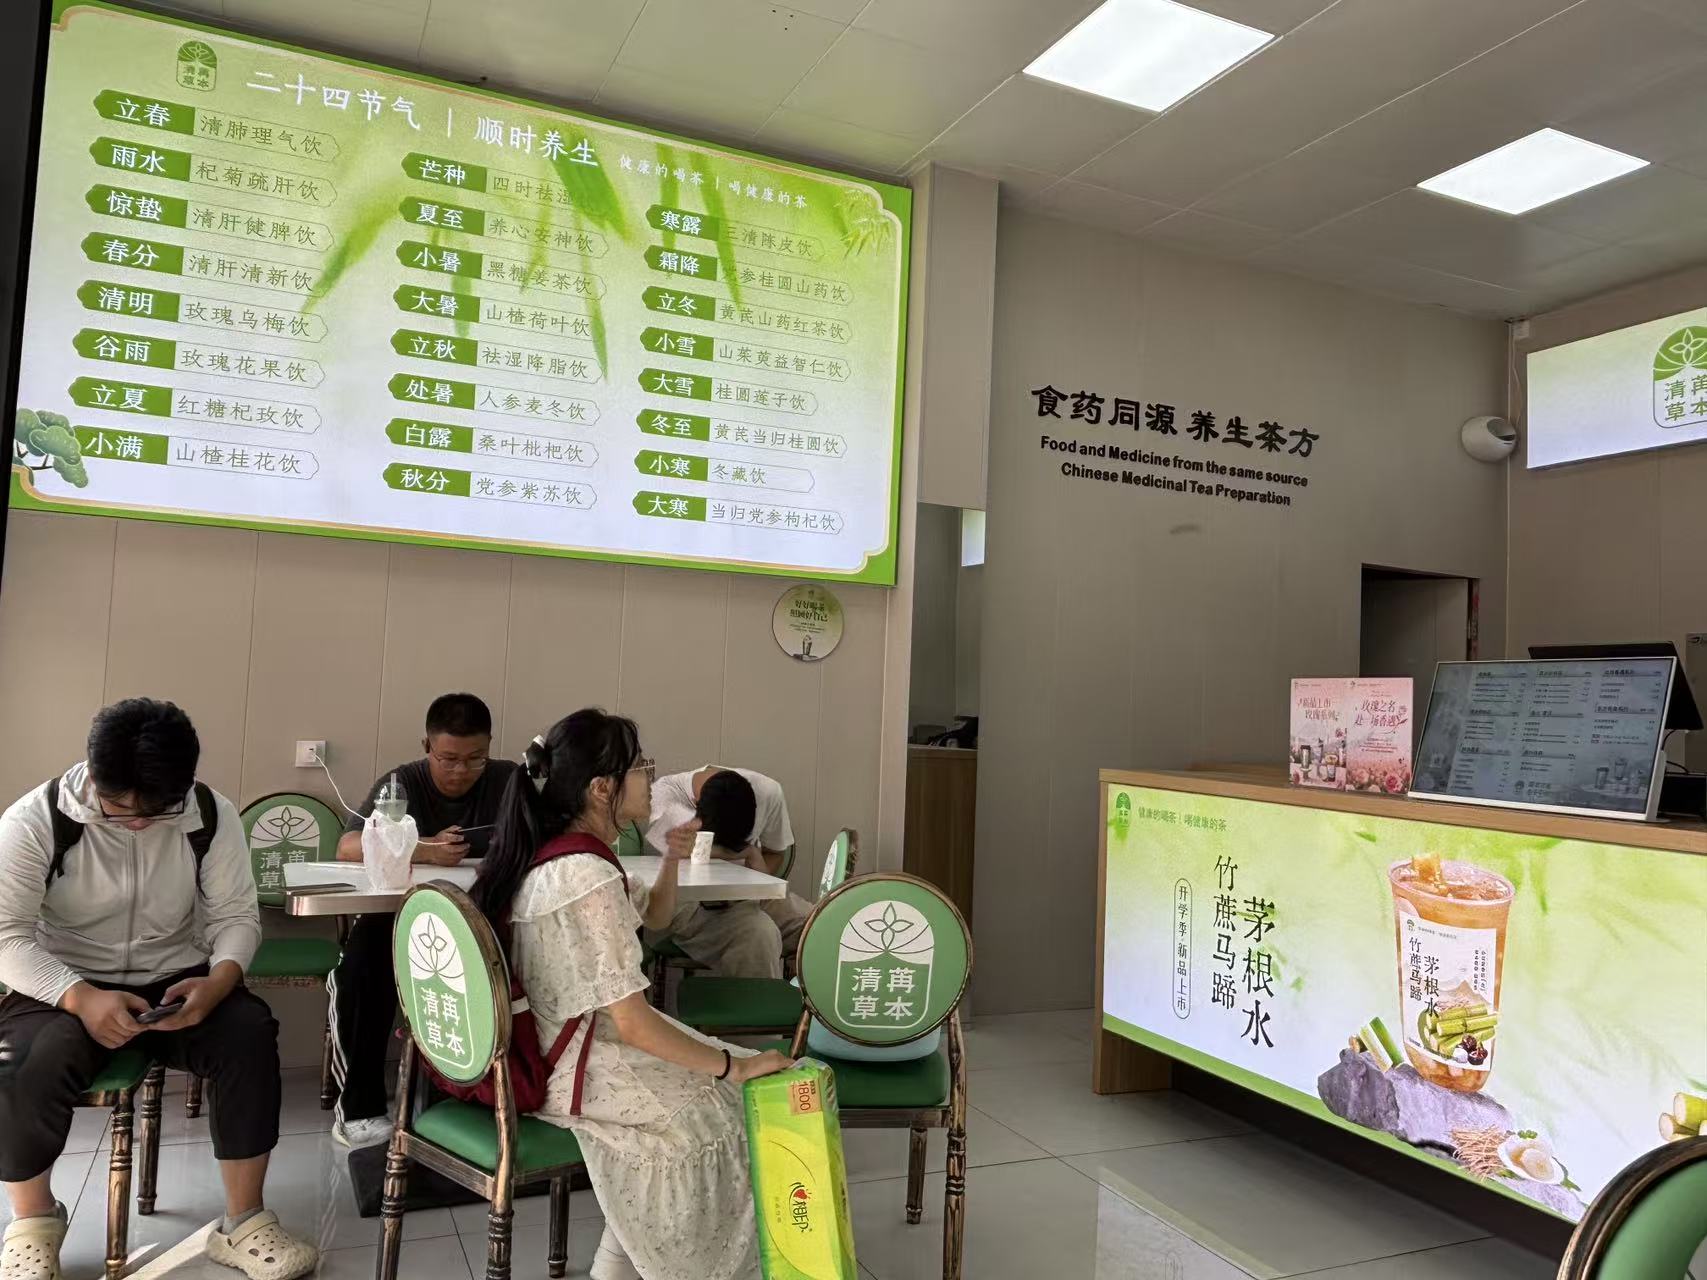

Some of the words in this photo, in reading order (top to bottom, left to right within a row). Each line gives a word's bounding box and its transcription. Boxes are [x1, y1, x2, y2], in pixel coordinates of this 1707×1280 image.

[114, 98, 171, 126] 立春
[246, 71, 421, 131] 二十四节气
[473, 117, 598, 168] 顺时养生
[200, 115, 323, 157] 清肺理气饮
[111, 142, 167, 174] 雨水
[419, 159, 466, 185] 芒种
[195, 160, 320, 202] 杞菊疏肝饮
[620, 154, 703, 186] 健康的喝茶
[729, 180, 807, 208] 喝健康的茶
[106, 189, 163, 221] 惊蛰
[416, 202, 464, 230] 夏至
[192, 207, 317, 247] 清肝健脾饮
[489, 217, 594, 253] 养心安神饮
[660, 210, 701, 236] 寒露
[102, 237, 160, 268] 春分
[413, 247, 461, 272] 小暑
[659, 255, 700, 276] 霜降
[188, 253, 314, 293] 清肝清新饮
[725, 265, 845, 302] 参桂圆山药饮
[98, 287, 153, 315] 清明
[411, 290, 459, 316] 大暑
[657, 293, 697, 316] 立冬
[185, 302, 311, 337] 玫瑰乌梅饮
[486, 303, 591, 337] 山楂荷叶饮
[720, 303, 845, 341] 黄芪山药红茶饮
[93, 335, 151, 363] 谷雨
[408, 336, 457, 360] 立秋
[655, 333, 696, 356] 小雪
[181, 349, 307, 383] 玫瑰花果饮
[481, 346, 589, 379] 祛湿降脂饮
[718, 344, 842, 378] 山茱萸益智仁饮
[90, 385, 147, 412] 立夏
[405, 379, 454, 404] 处暑
[653, 374, 694, 397] 大雪
[715, 383, 806, 411] 桂圆莲子饮
[177, 395, 304, 429] 红糖杞玫饮
[480, 389, 587, 421] 人参麦冬饮
[651, 414, 692, 437] 冬至
[1031, 384, 1178, 436] 食药同源
[1186, 410, 1320, 458] 养生茶方
[85, 432, 144, 460] 小满
[405, 424, 452, 448] 白露
[478, 434, 584, 463] 桑叶枇杷饮
[713, 423, 840, 455] 黄芪当归桂圆饮
[177, 443, 301, 475] 山楂桂花饮
[649, 455, 690, 477] 小寒
[712, 463, 767, 484] 冬藏饮
[1041, 435, 1077, 453] Food
[1079, 444, 1106, 458] and
[1108, 445, 1170, 468] Medicine
[1173, 455, 1204, 472] from
[1206, 460, 1227, 476] the
[1229, 465, 1263, 481] same
[1265, 470, 1308, 488] source
[400, 468, 450, 491] 秋分
[476, 477, 583, 505] 党参紫苏饮
[1061, 462, 1119, 483] Chinese
[1121, 470, 1187, 493] Medicinal
[1188, 480, 1213, 496] Tea
[1215, 484, 1291, 507] Preparation
[647, 495, 689, 518] 大寒
[711, 503, 837, 531] 当归党参枸杞饮
[259, 871, 286, 889] 草
[1212, 855, 1238, 1010] 竹蔗马蹄
[852, 967, 916, 994] 清苒
[1241, 896, 1275, 1048] 茅根水
[1424, 955, 1440, 1018] 茅根水
[421, 987, 460, 1027] 清苒
[850, 996, 914, 1021] 草本
[426, 1019, 466, 1058] 草本
[798, 1082, 811, 1111] 1800
